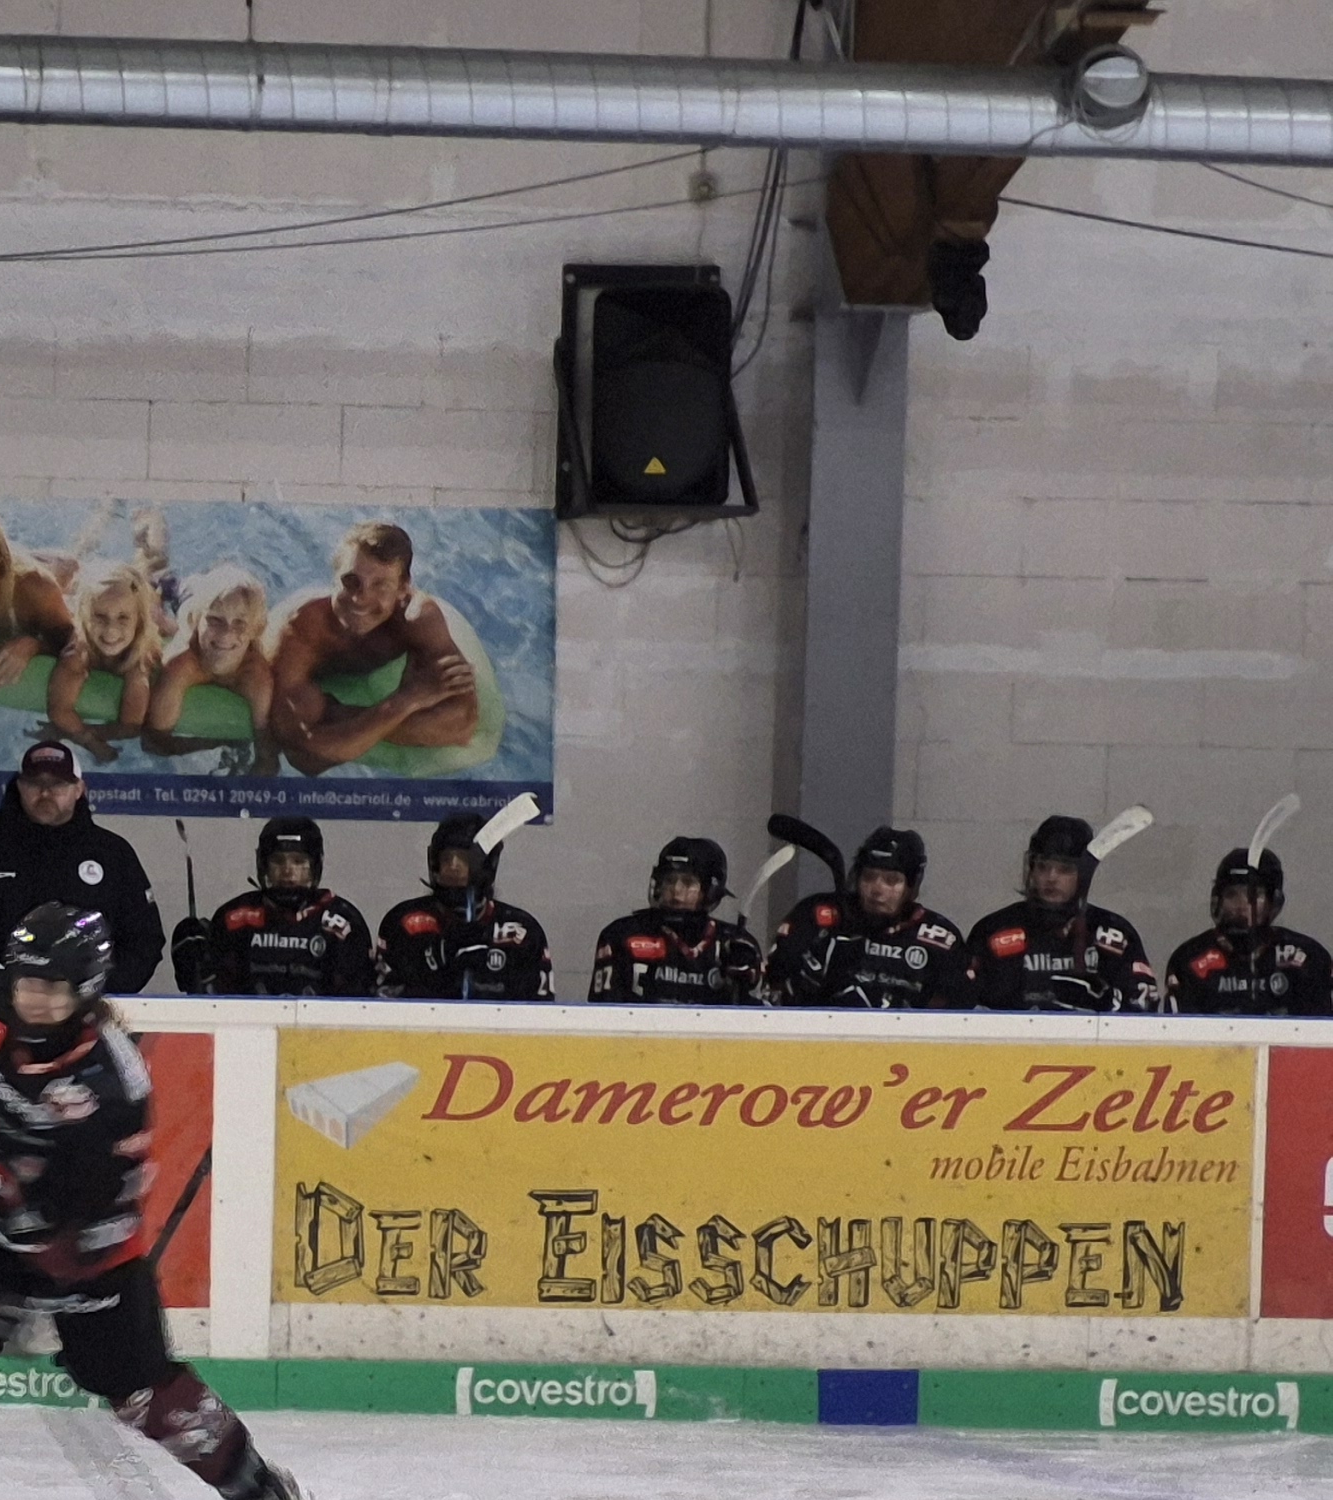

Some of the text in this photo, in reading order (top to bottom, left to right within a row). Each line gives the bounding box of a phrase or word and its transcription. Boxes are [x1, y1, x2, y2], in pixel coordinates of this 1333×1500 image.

[85, 787, 141, 803] ippstadt
[250, 932, 309, 950] Allianz
[655, 965, 705, 985] Allianz
[1005, 1062, 1235, 1136] Zelte
[930, 1143, 1239, 1186] mobile Eisbahnen
[292, 1180, 489, 1303] DER
[529, 1187, 1187, 1314] EISSCHUPPEN
[472, 1371, 633, 1408] covestro
[1115, 1383, 1277, 1419] covestro
